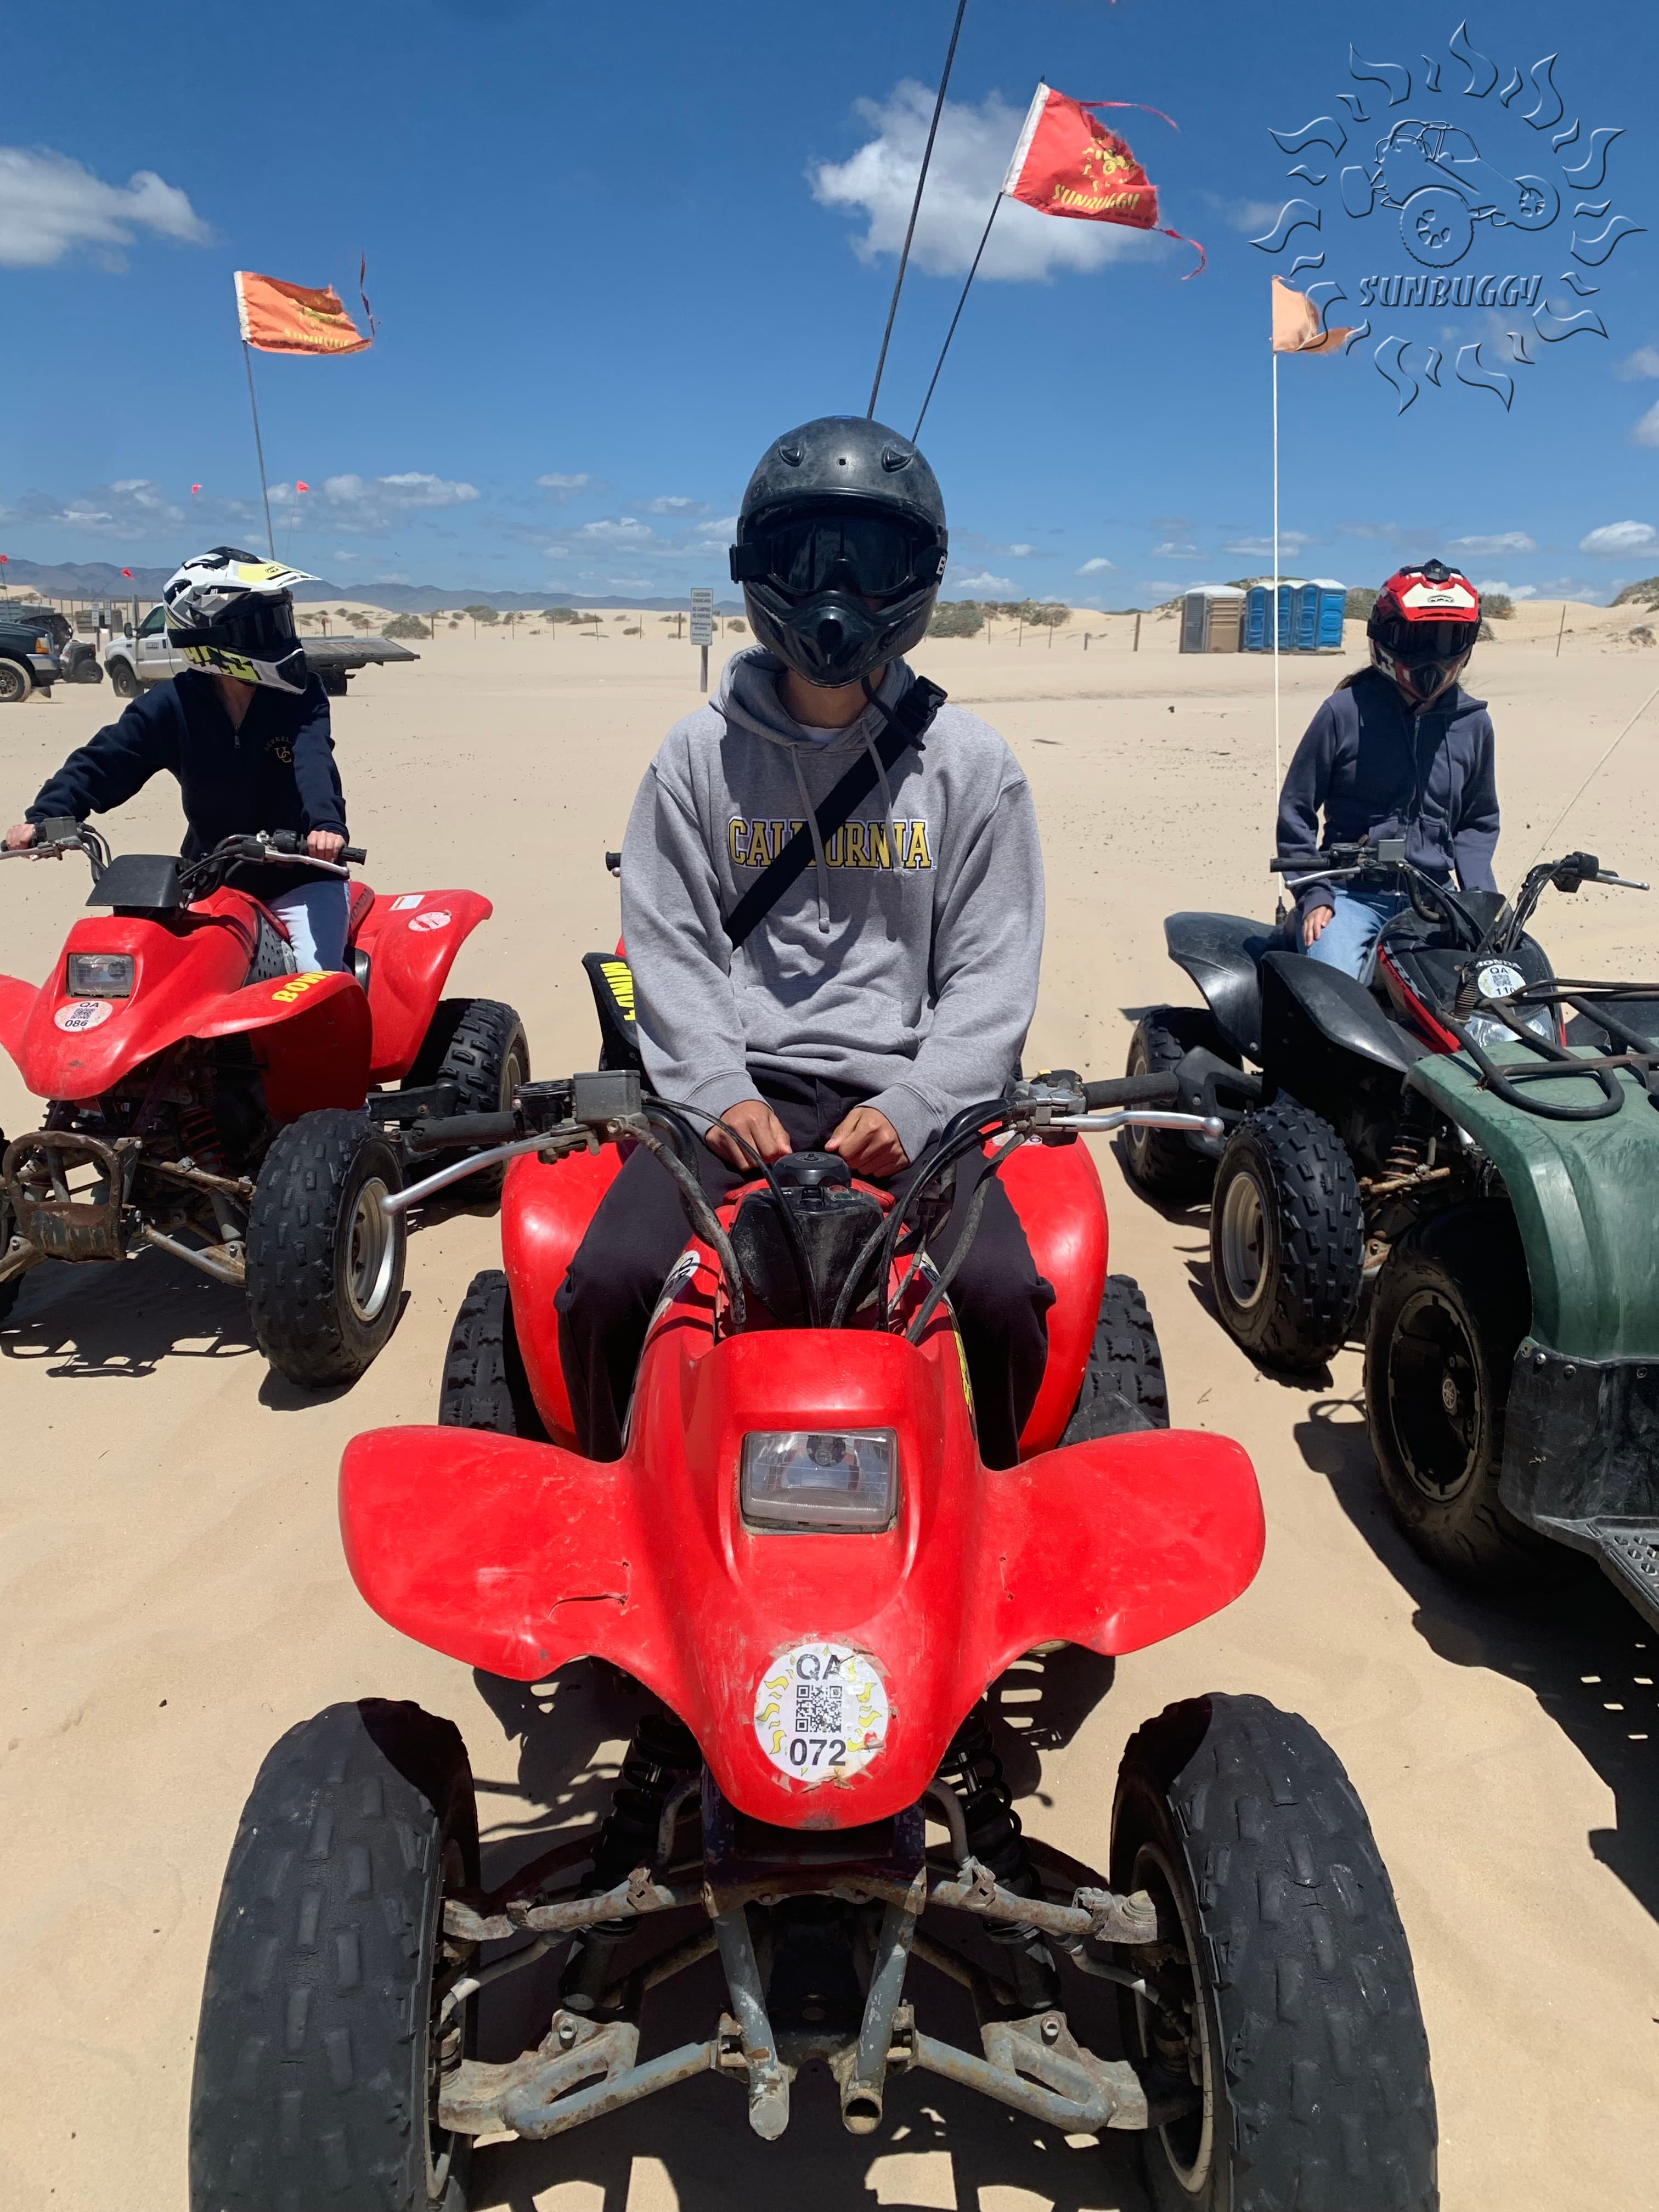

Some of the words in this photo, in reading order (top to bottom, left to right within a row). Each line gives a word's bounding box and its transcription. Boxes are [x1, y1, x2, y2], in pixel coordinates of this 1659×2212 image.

[729, 819, 934, 869] CALORNIA
[65, 1019, 89, 1028] 086
[796, 1654, 843, 1681] QA
[789, 1738, 847, 1767] 072
